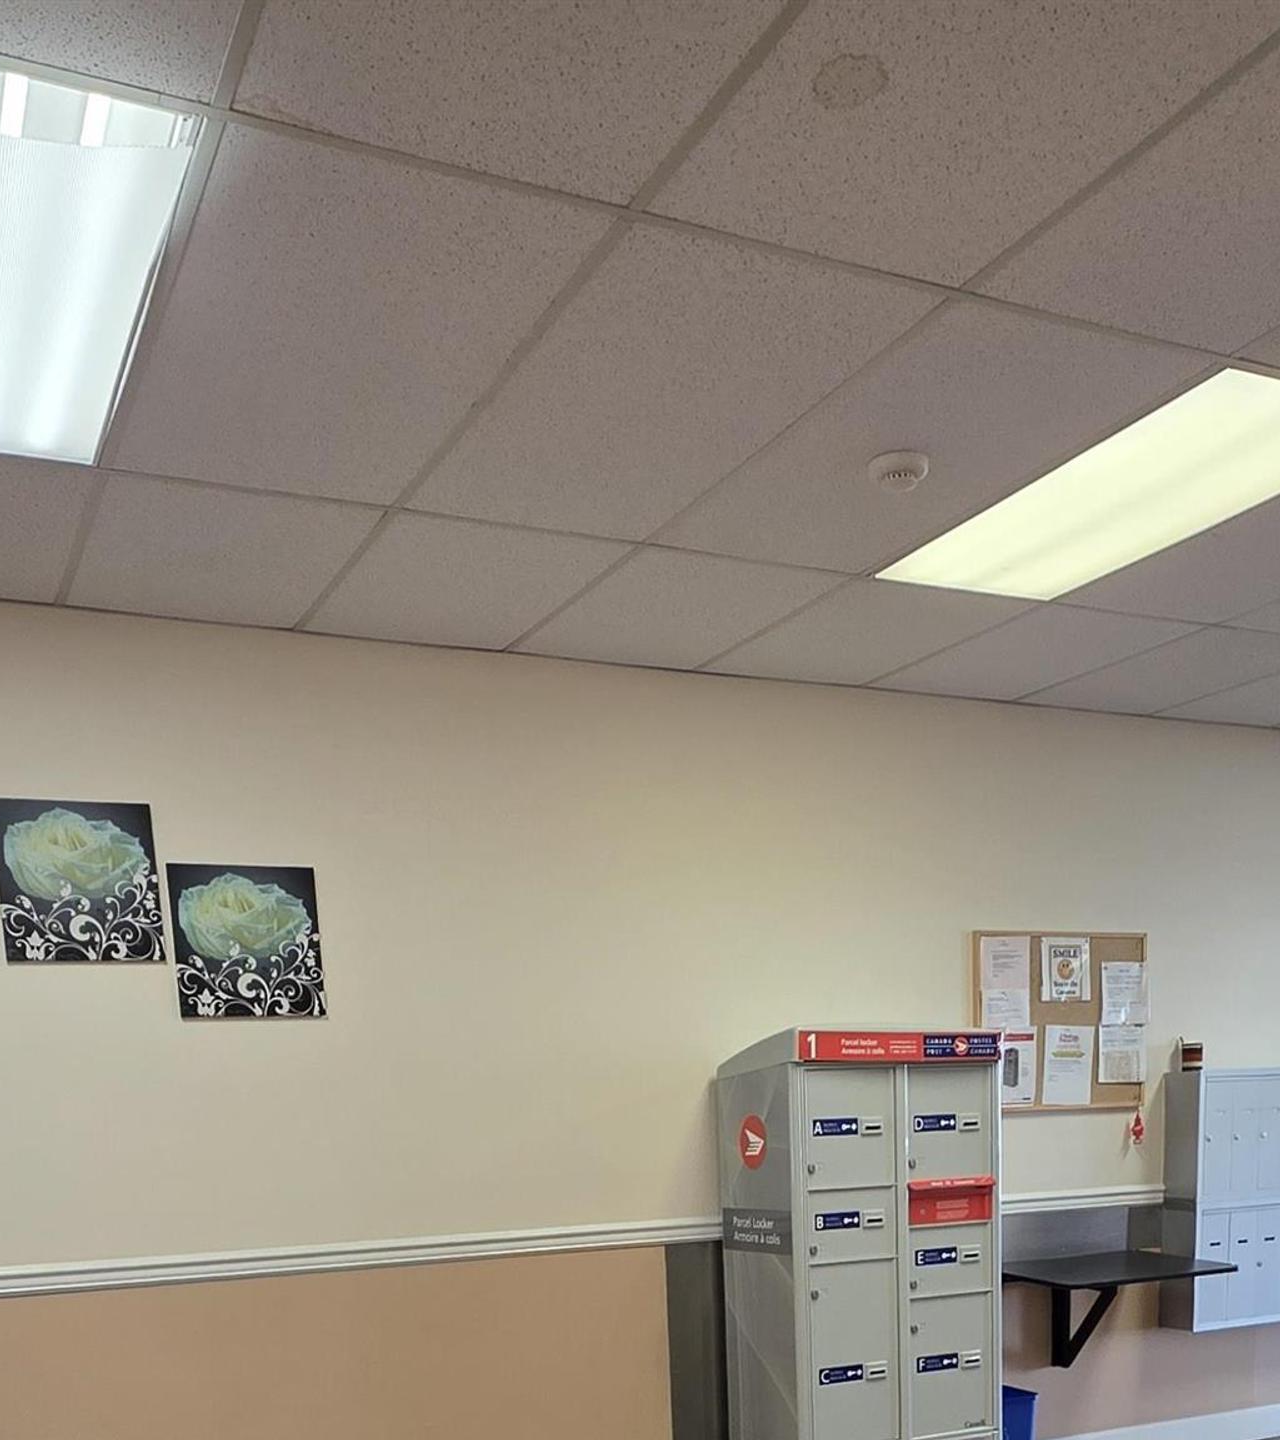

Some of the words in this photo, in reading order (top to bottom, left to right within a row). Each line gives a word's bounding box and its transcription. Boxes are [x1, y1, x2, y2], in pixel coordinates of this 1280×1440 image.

[1052, 948, 1079, 959] SMILE
[807, 1033, 816, 1058] 1
[813, 1121, 823, 1135] A
[914, 1117, 924, 1130] D
[816, 1216, 824, 1229] B
[917, 1251, 924, 1264] E
[919, 1358, 926, 1371] F
[821, 1370, 830, 1383] C
